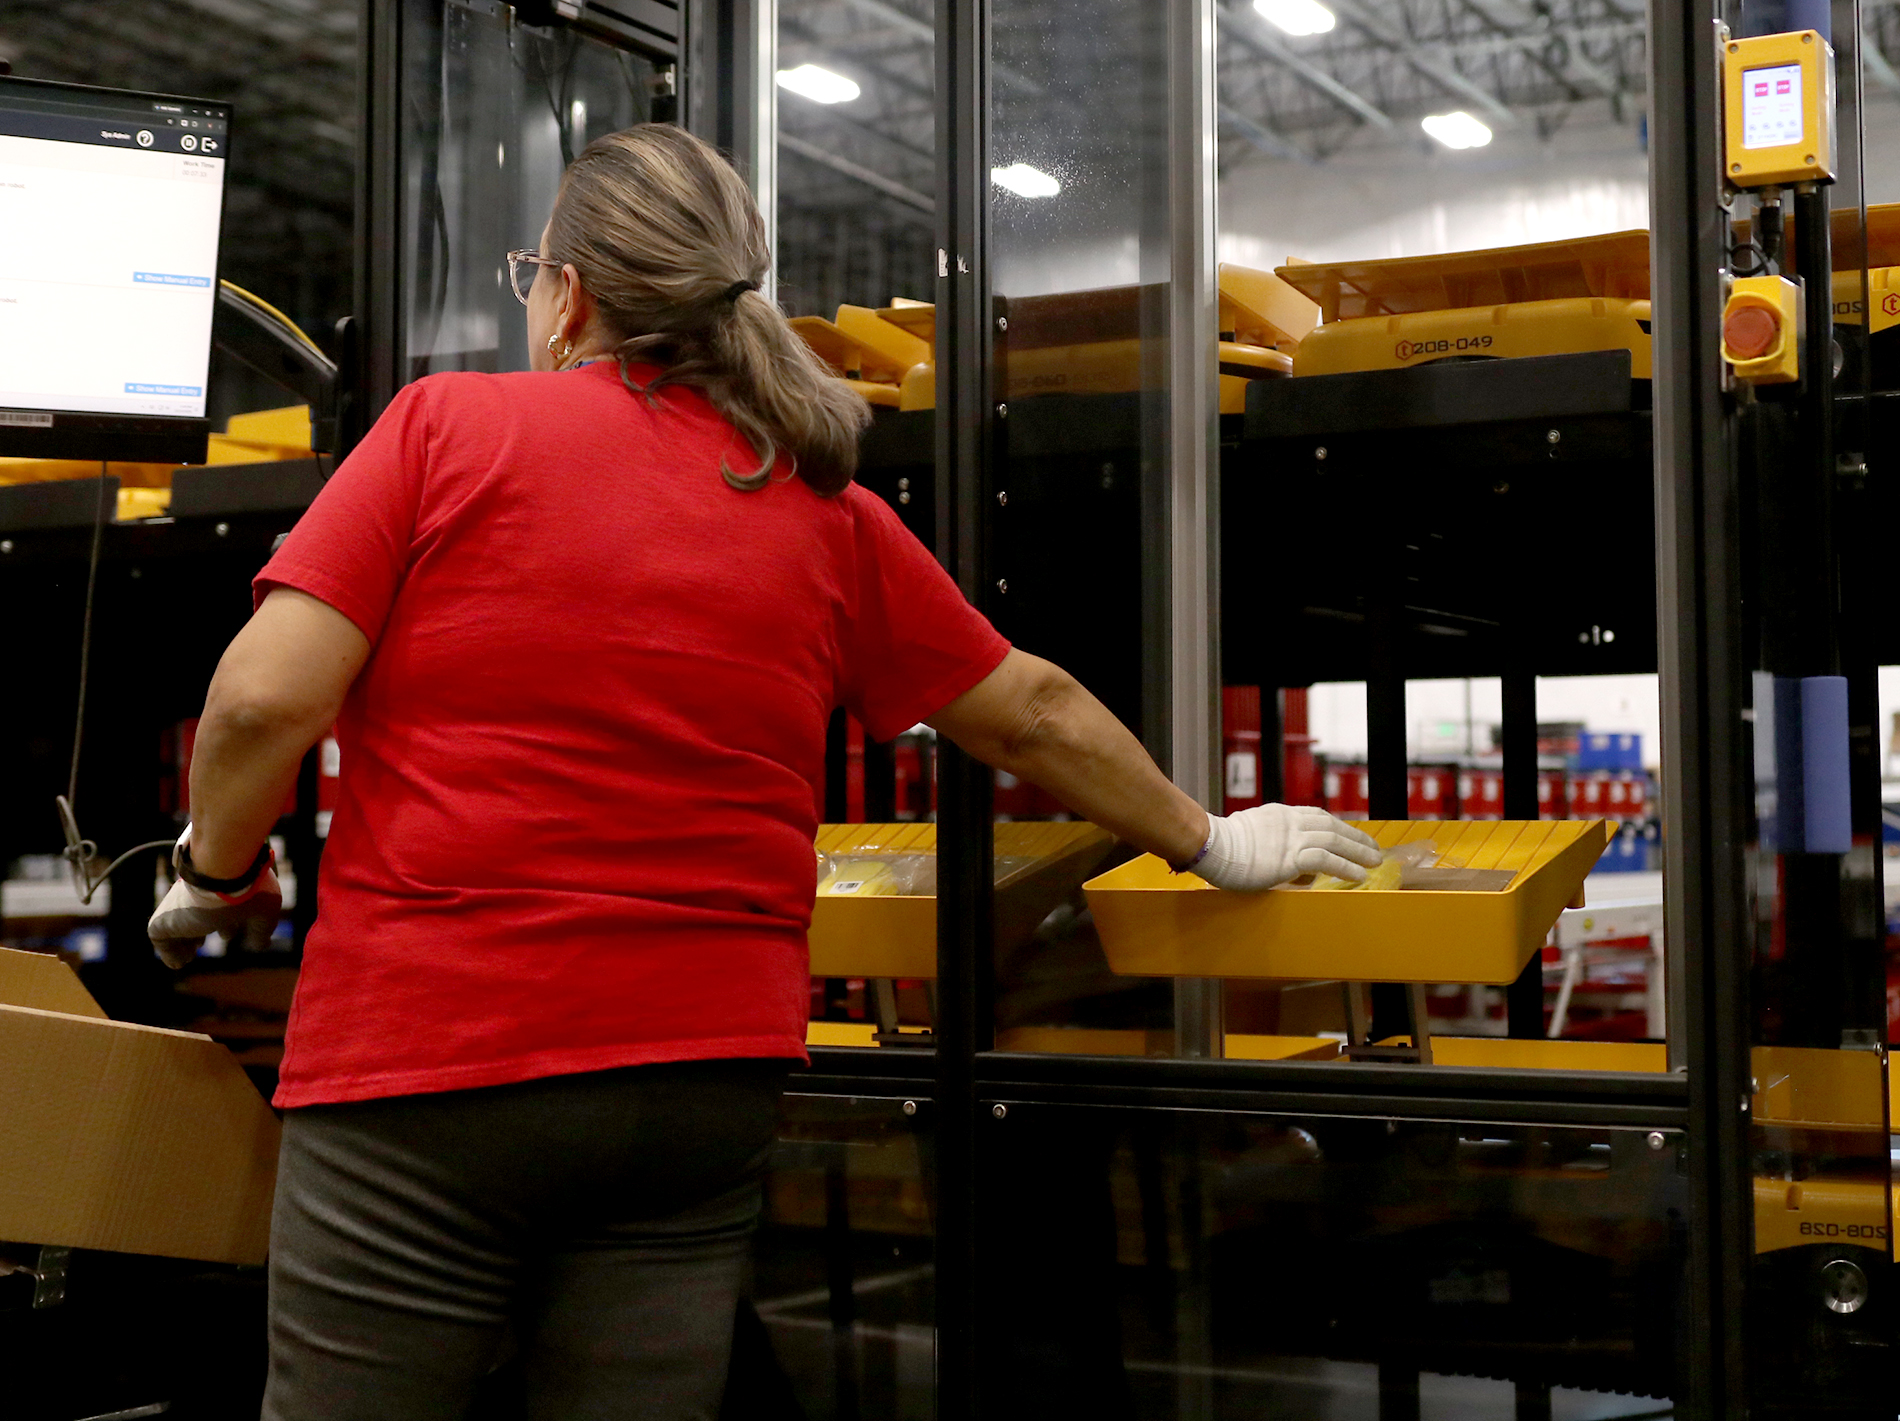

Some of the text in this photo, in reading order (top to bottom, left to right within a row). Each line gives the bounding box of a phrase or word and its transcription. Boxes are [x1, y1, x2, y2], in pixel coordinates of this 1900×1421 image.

[144, 274, 207, 286] Show Manual Entry
[1413, 335, 1493, 354] 208-049
[135, 384, 198, 396] Show Manual Entry
